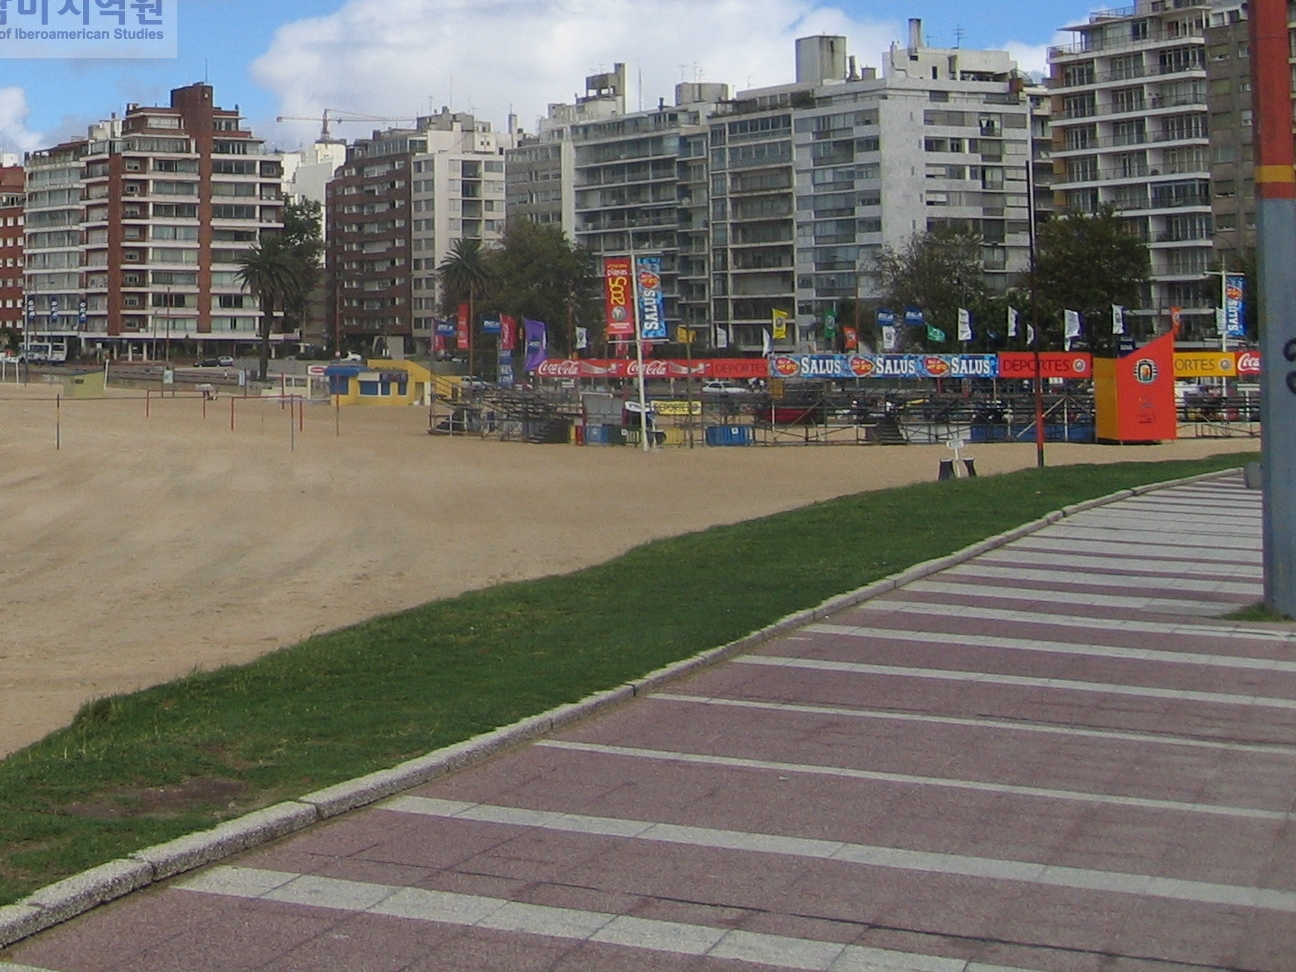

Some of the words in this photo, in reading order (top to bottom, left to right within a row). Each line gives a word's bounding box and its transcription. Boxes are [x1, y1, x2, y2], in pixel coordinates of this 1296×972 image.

[608, 276, 627, 306] 2005
[643, 289, 659, 330] SALUS
[1227, 301, 1239, 331] SALUS
[715, 363, 767, 373] DEPORTES
[801, 357, 841, 374] SALUS
[876, 357, 916, 374] SALUS
[951, 357, 990, 374] SALUS
[1003, 359, 1070, 371] DEPORTES
